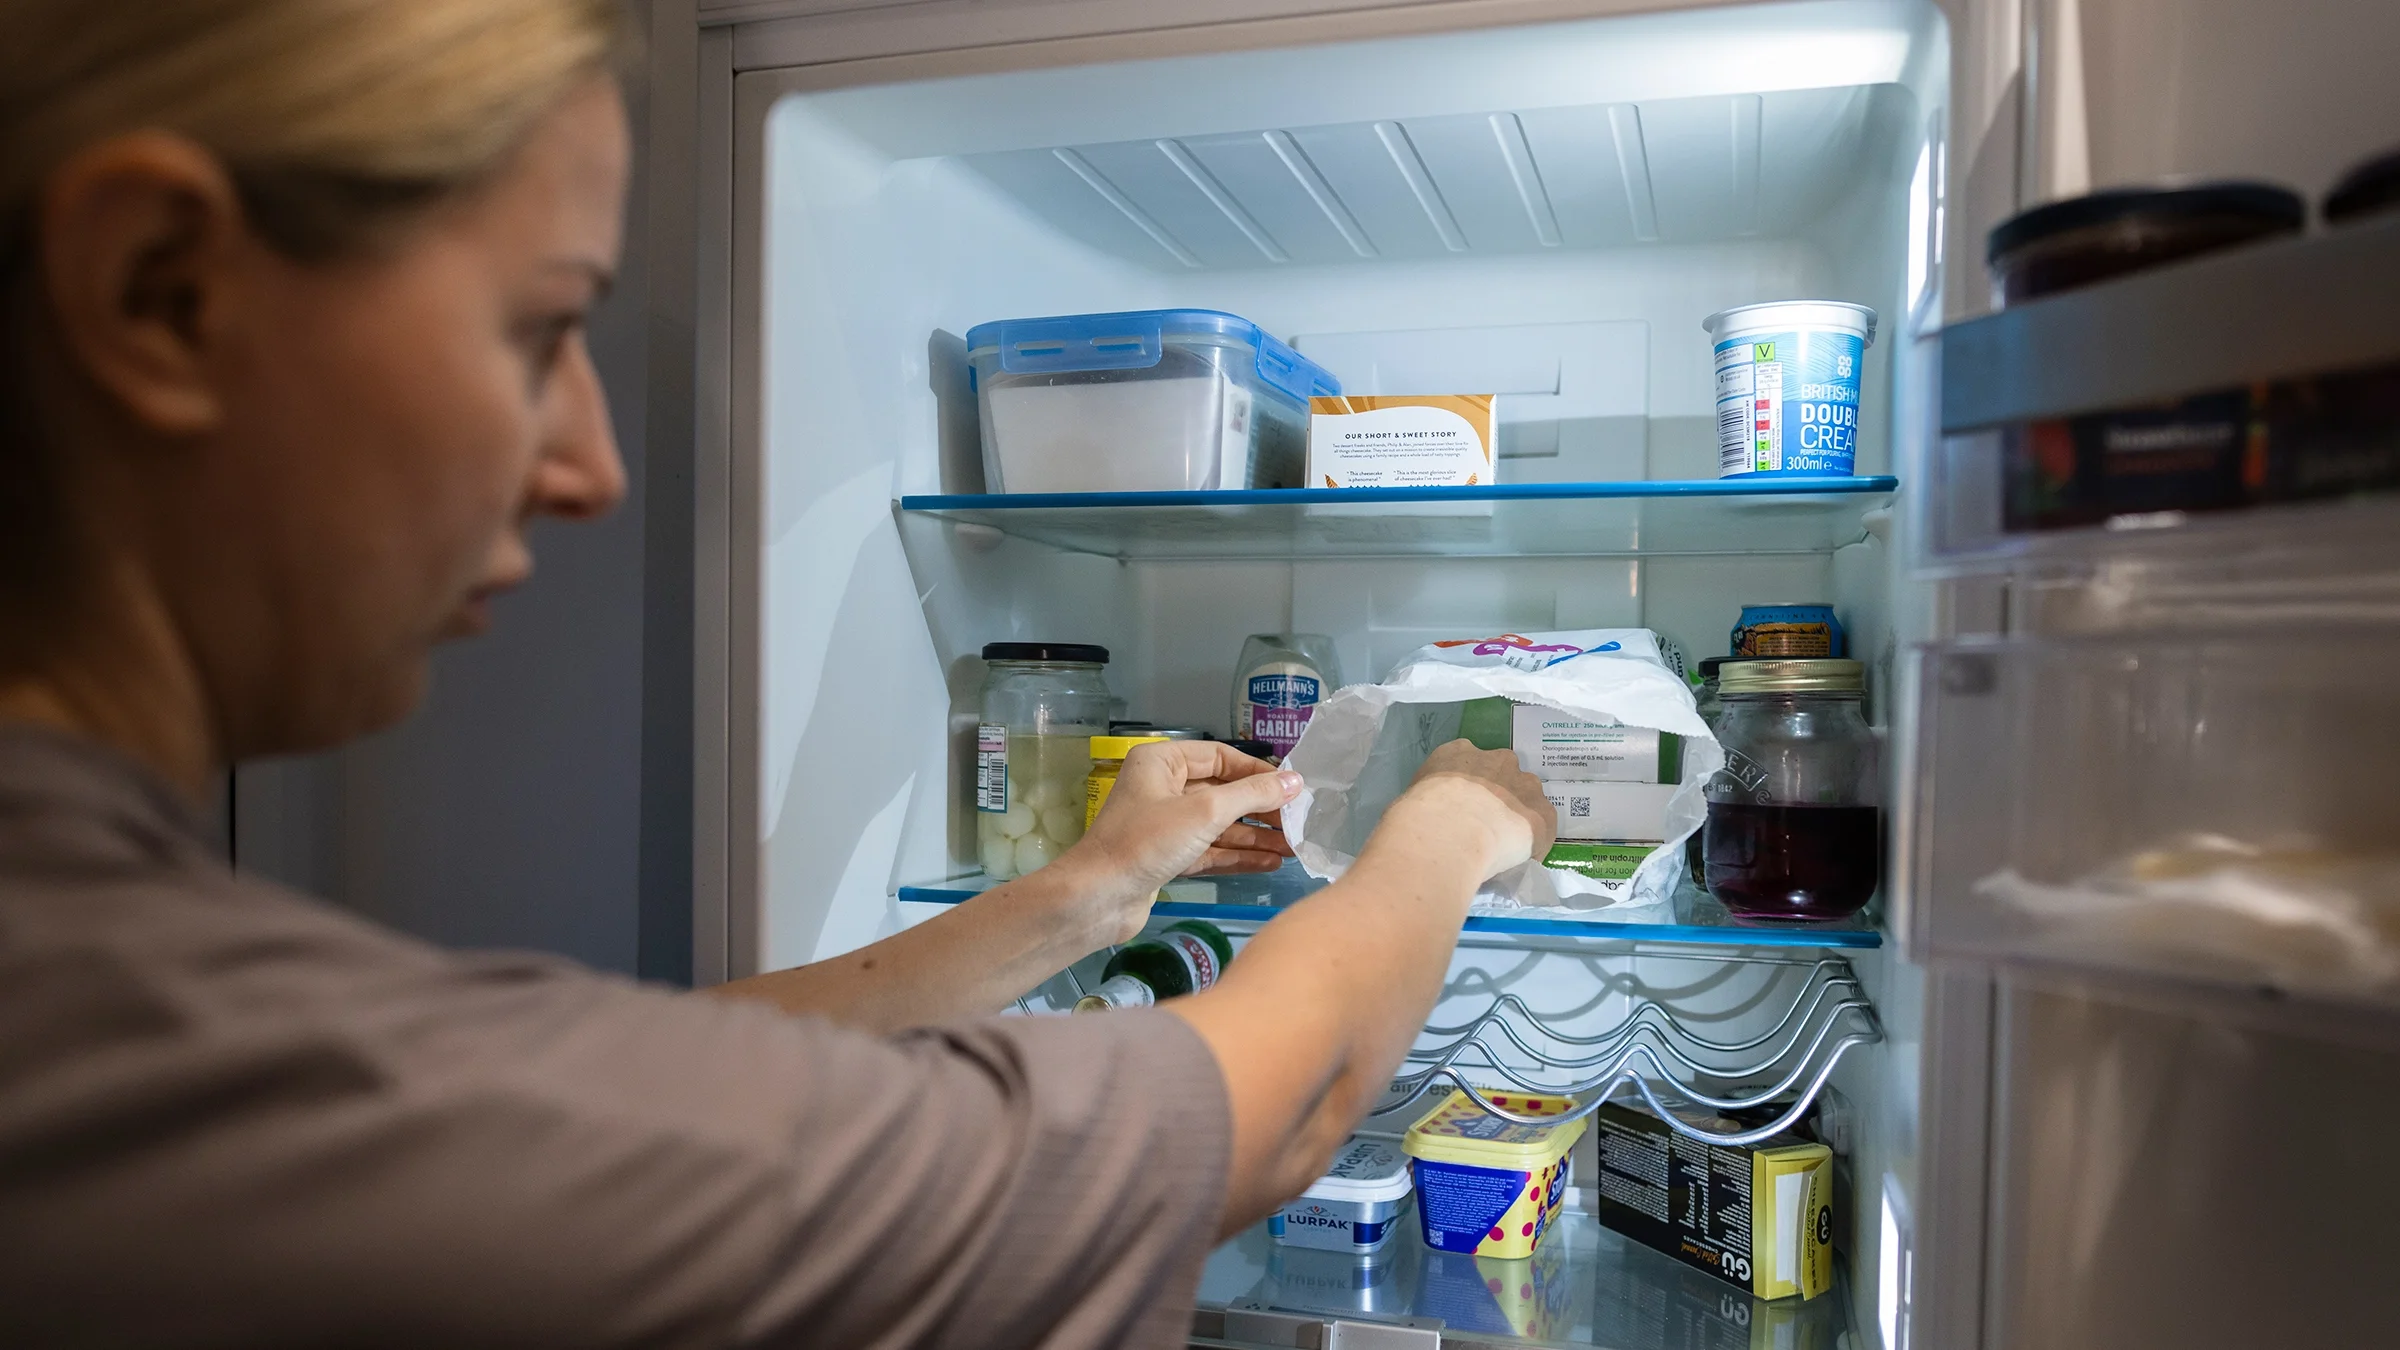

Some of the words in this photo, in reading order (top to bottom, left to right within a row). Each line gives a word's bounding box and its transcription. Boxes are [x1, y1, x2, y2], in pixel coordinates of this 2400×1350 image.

[1759, 344, 1770, 358] V
[1801, 383, 1850, 402] BRITISH
[1786, 456, 1823, 471] 300ml
[1253, 680, 1315, 696] HELLMANN'S
[1592, 854, 1608, 862] alfa
[1573, 866, 1603, 876] injecti
[1605, 867, 1617, 876] for
[1328, 1143, 1381, 1178] LURPAK
[1288, 1213, 1349, 1231] LURPAK
